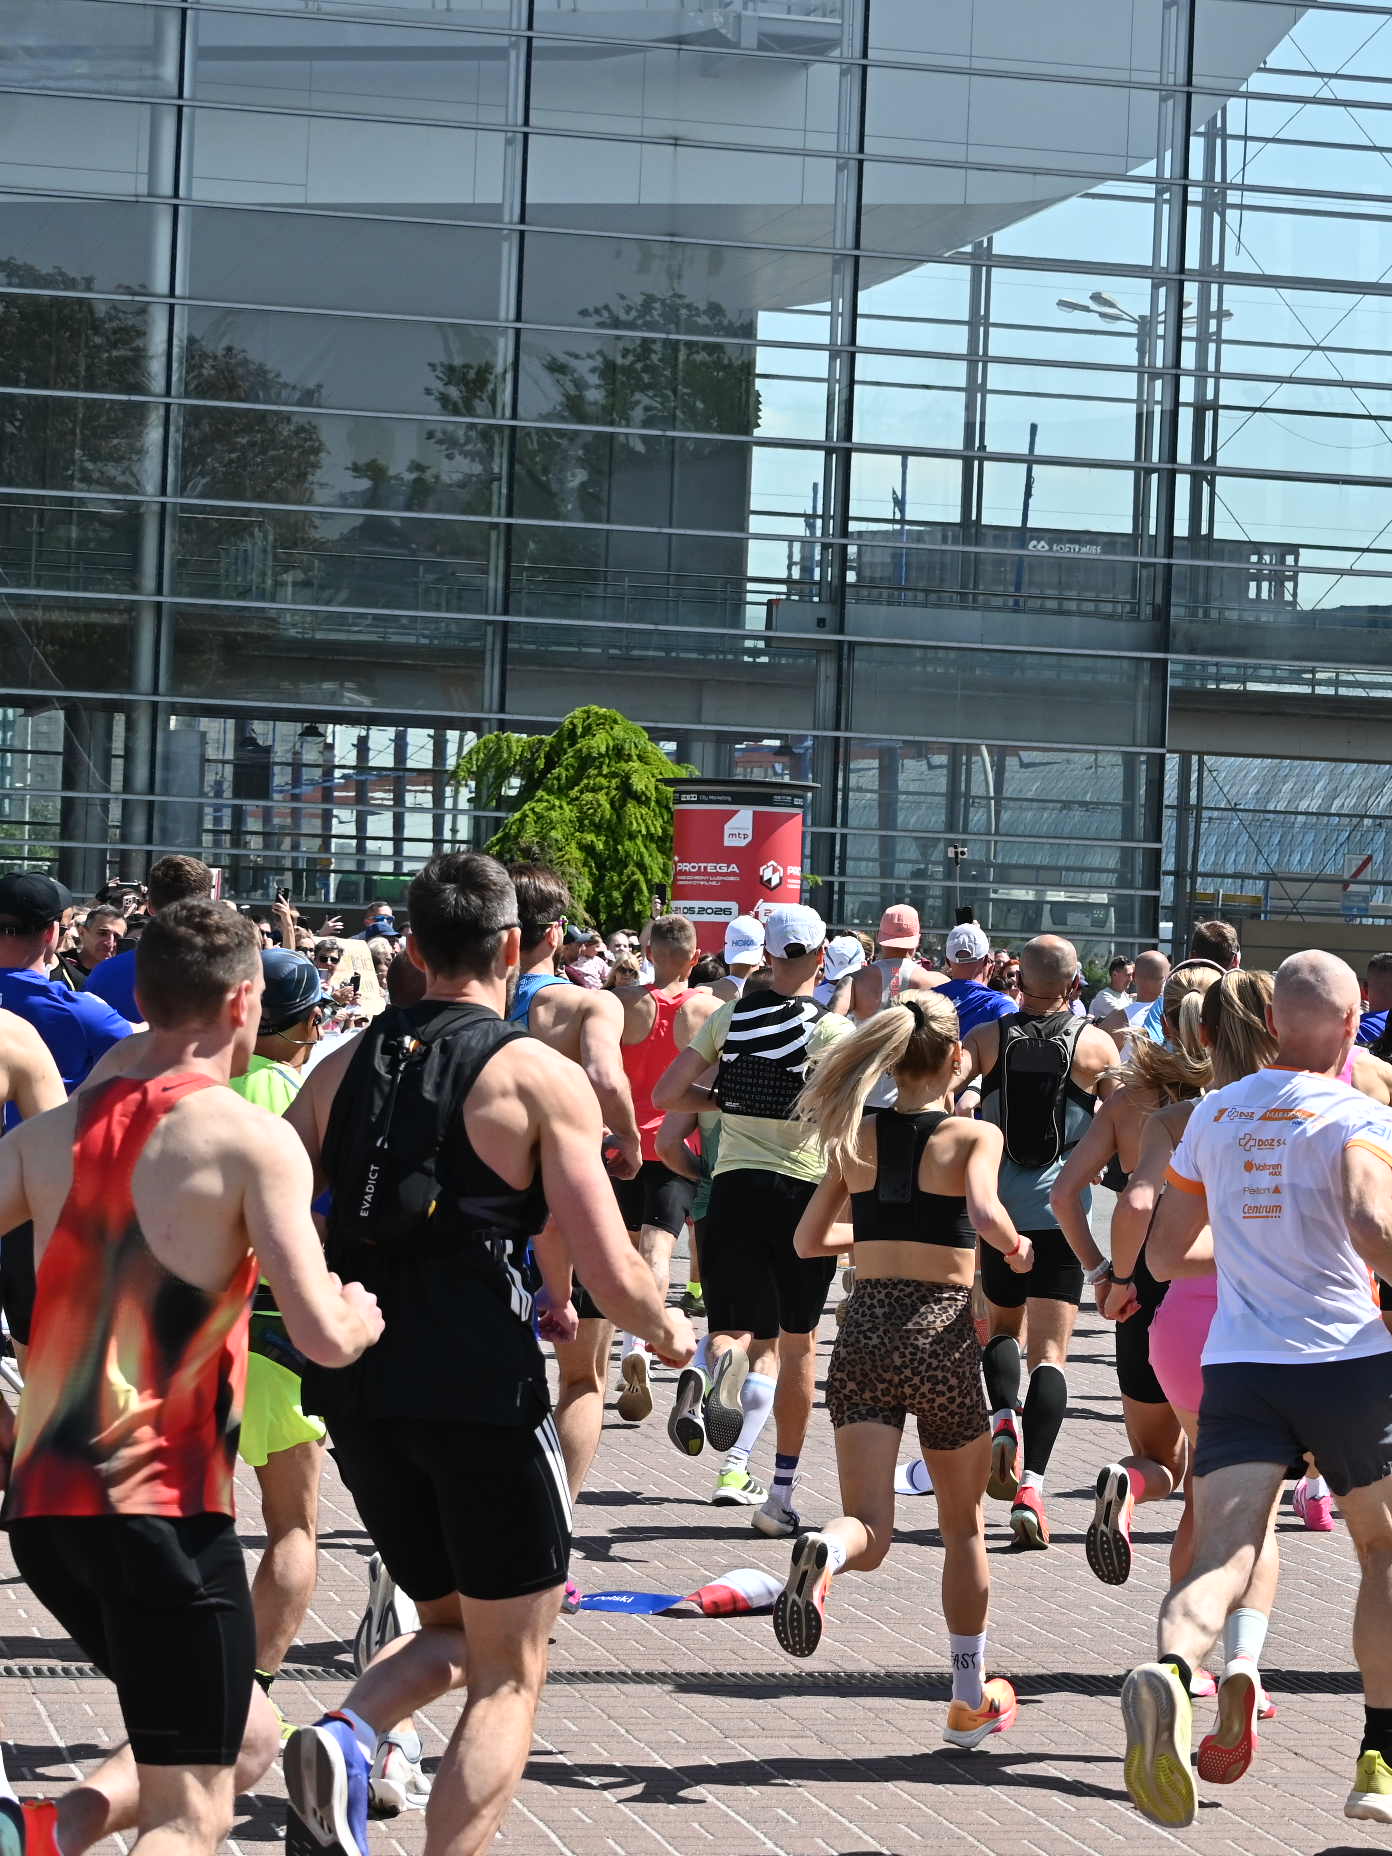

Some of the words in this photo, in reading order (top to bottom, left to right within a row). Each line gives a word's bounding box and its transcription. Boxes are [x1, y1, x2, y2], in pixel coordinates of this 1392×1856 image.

[676, 862, 740, 873] PROTEGA
[359, 1163, 380, 1217] EVADICT
[1242, 1203, 1282, 1215] Centrum
